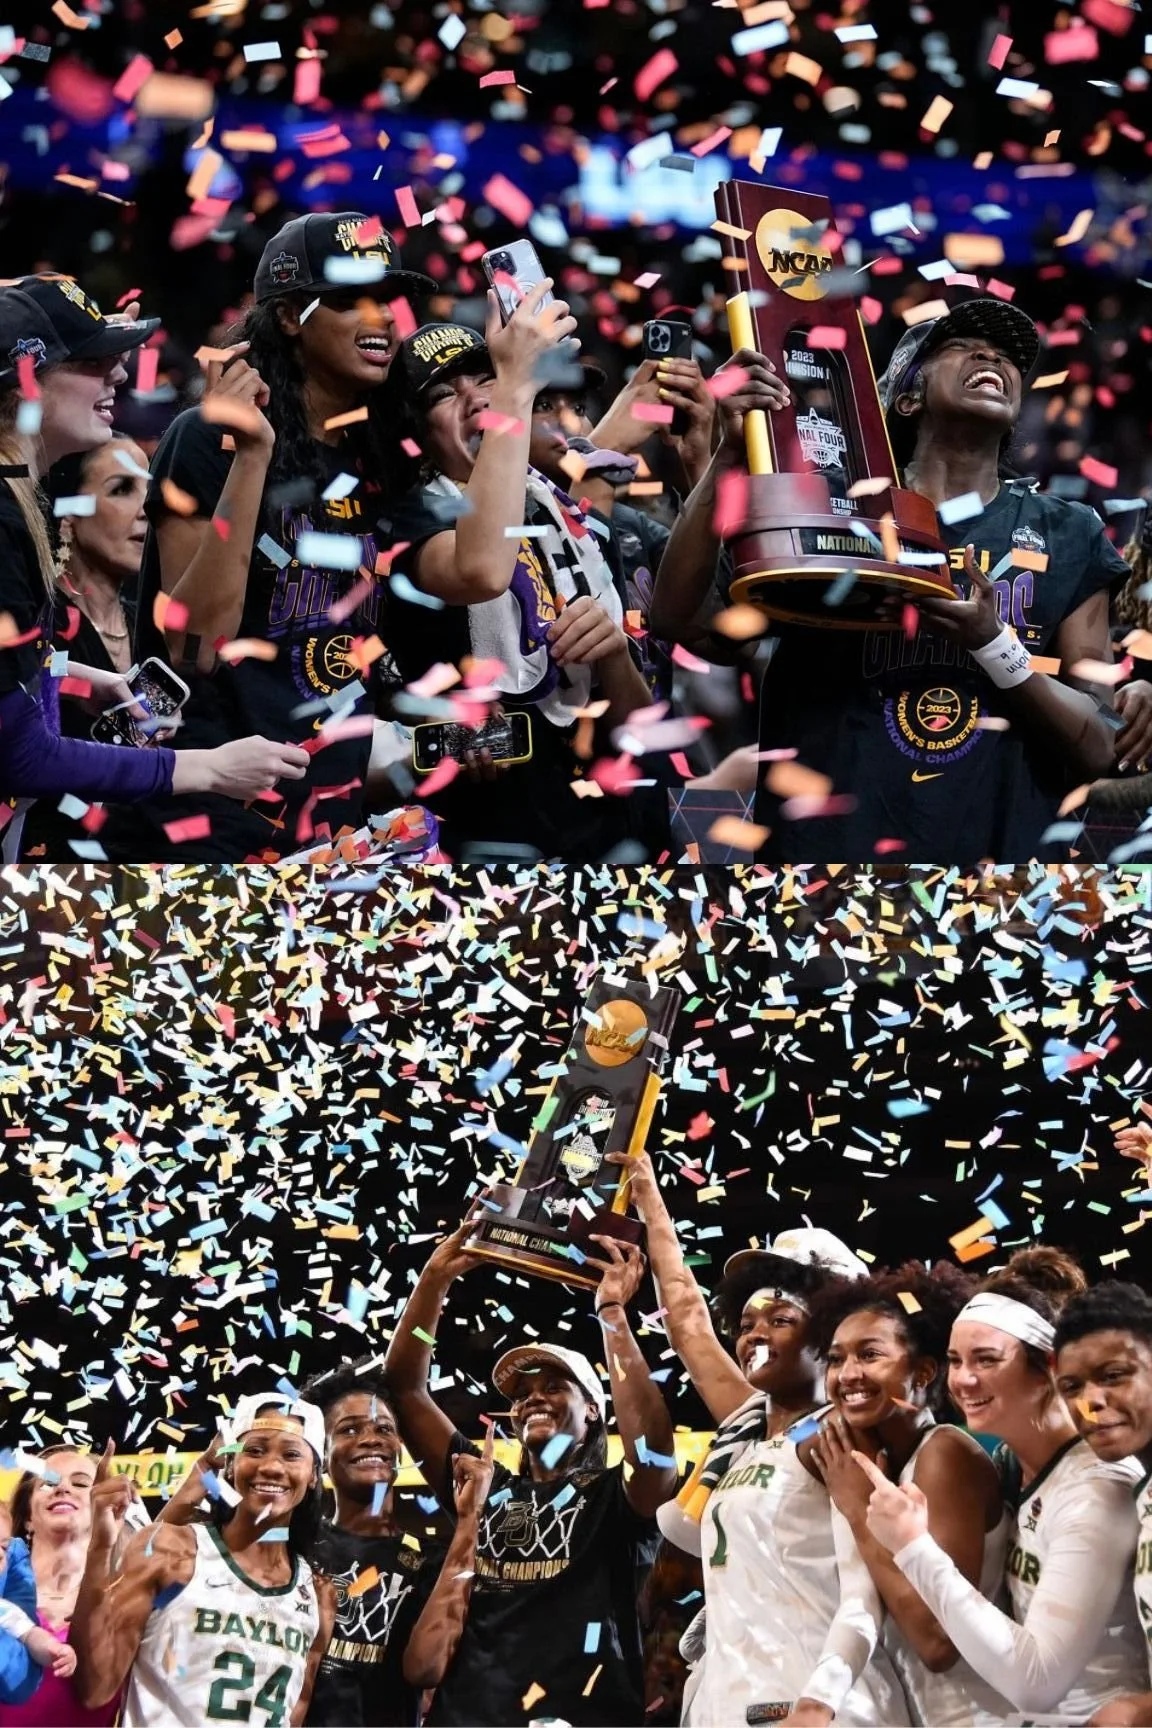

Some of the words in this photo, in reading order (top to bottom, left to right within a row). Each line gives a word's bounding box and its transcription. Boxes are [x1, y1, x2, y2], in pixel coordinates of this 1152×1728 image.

[791, 350, 815, 364] 2023
[819, 431, 847, 449] FOUR
[926, 704, 952, 714] 2023
[897, 690, 926, 748] WOMEN'S
[927, 695, 979, 750] BASKETBALL
[489, 1226, 529, 1246] NATIONAL
[709, 1501, 728, 1568] 1
[206, 1650, 294, 1728] 24
